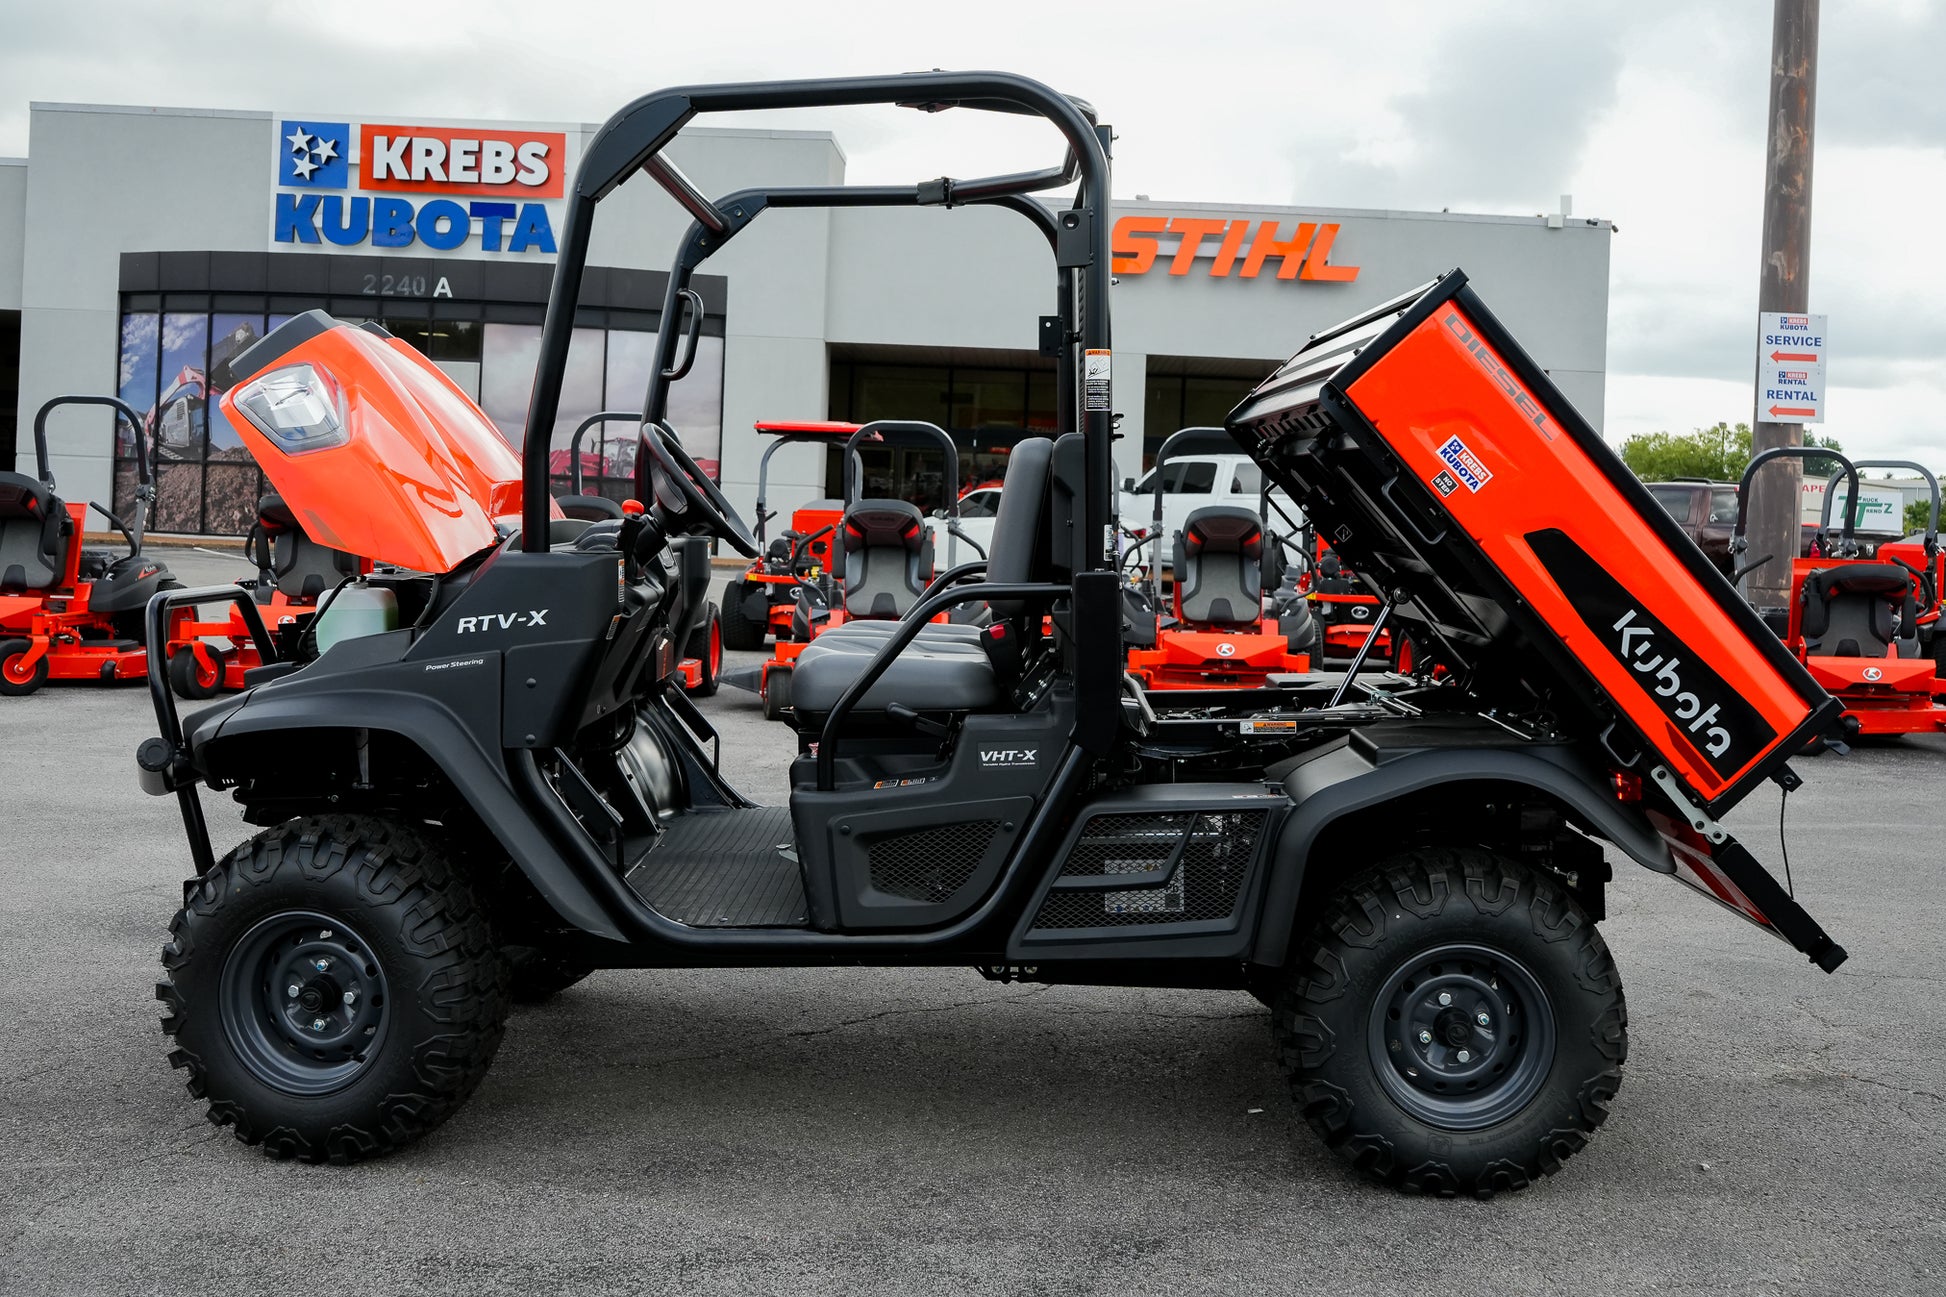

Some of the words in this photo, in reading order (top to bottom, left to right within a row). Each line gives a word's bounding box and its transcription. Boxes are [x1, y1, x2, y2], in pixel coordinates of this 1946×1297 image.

[372, 135, 550, 187] KREBS
[274, 192, 558, 254] KUBOTA
[1111, 216, 1361, 283] STIHL
[362, 274, 426, 296] 2240
[432, 276, 453, 298] A
[1766, 335, 1822, 347] SERVICE
[1443, 312, 1553, 441] DIESEL
[1778, 378, 1807, 386] RENTAL
[1766, 389, 1817, 402] RENTAL
[1439, 446, 1479, 491] KUBOTA
[1459, 451, 1488, 480] KREBS
[1434, 477, 1451, 494] STEP
[1442, 475, 1454, 487] NO
[457, 609, 549, 634] RTV-X
[425, 663, 450, 671] Power
[450, 658, 484, 668] Steering
[1612, 608, 1732, 759] Kubota
[980, 749, 1037, 761] VHT-X
